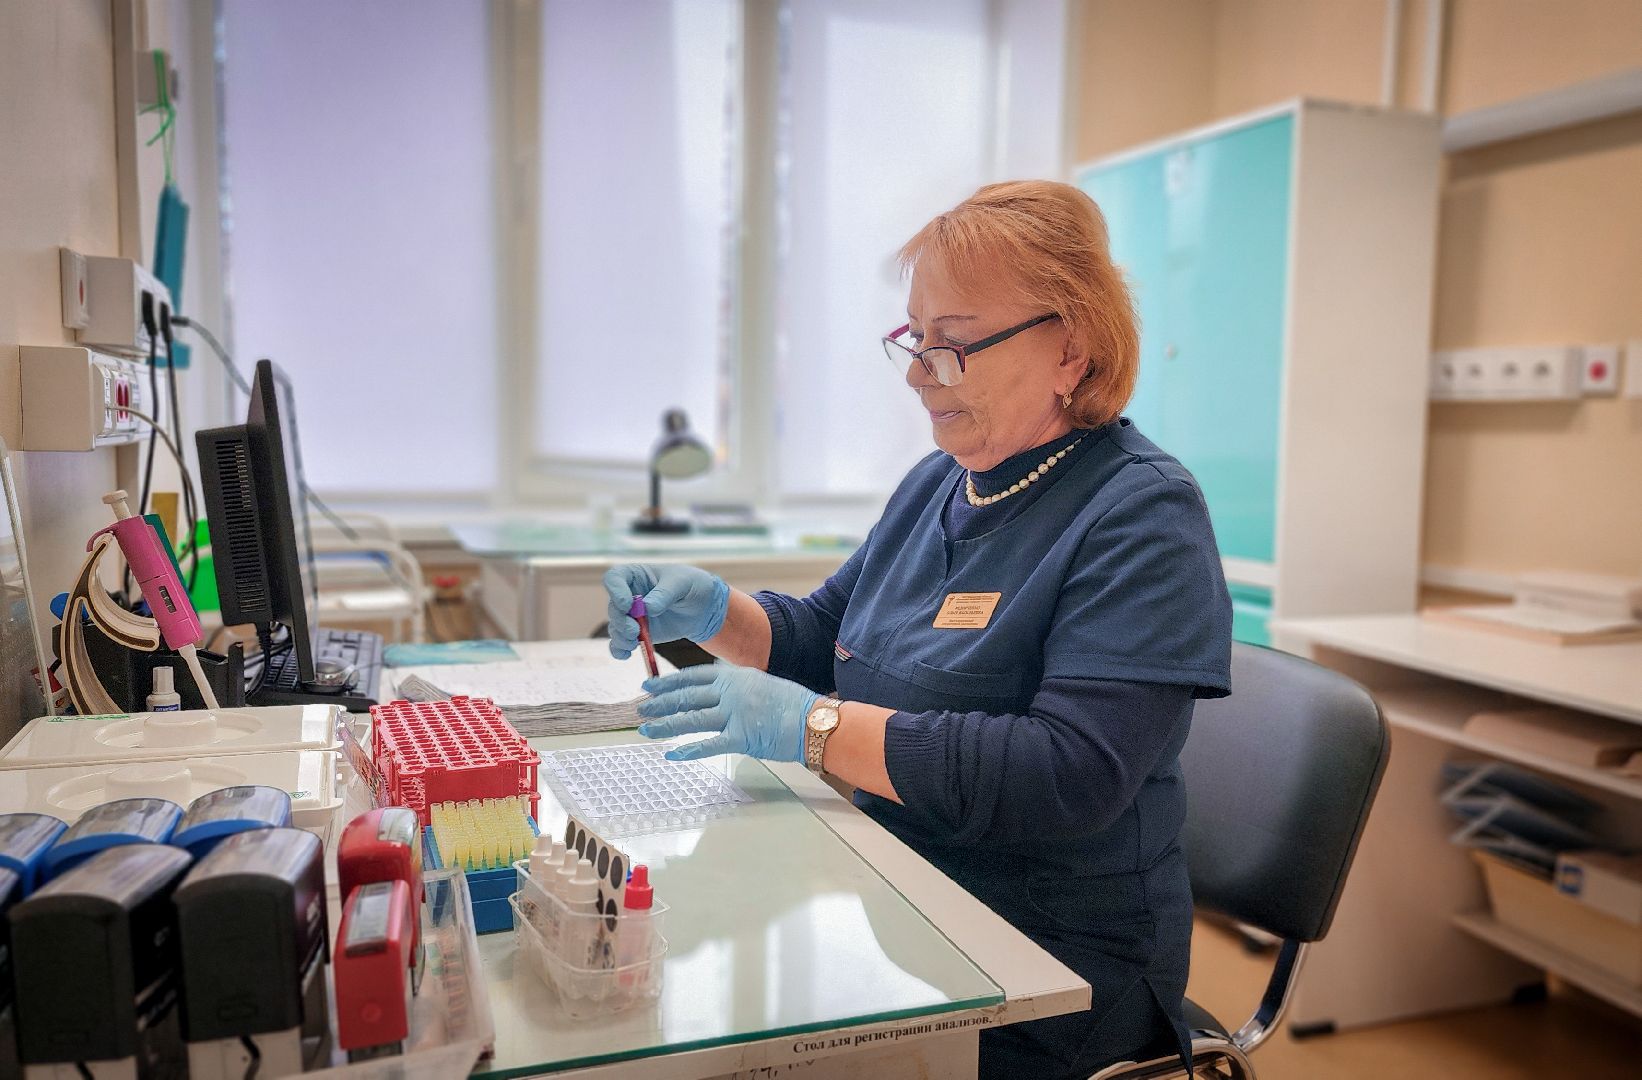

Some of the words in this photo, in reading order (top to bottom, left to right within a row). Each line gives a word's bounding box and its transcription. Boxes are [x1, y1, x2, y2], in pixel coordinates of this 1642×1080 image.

[793, 1041, 825, 1054] Стол
[827, 1037, 851, 1049] для
[854, 1024, 932, 1046] регистрации
[934, 1015, 993, 1032] анализов.
